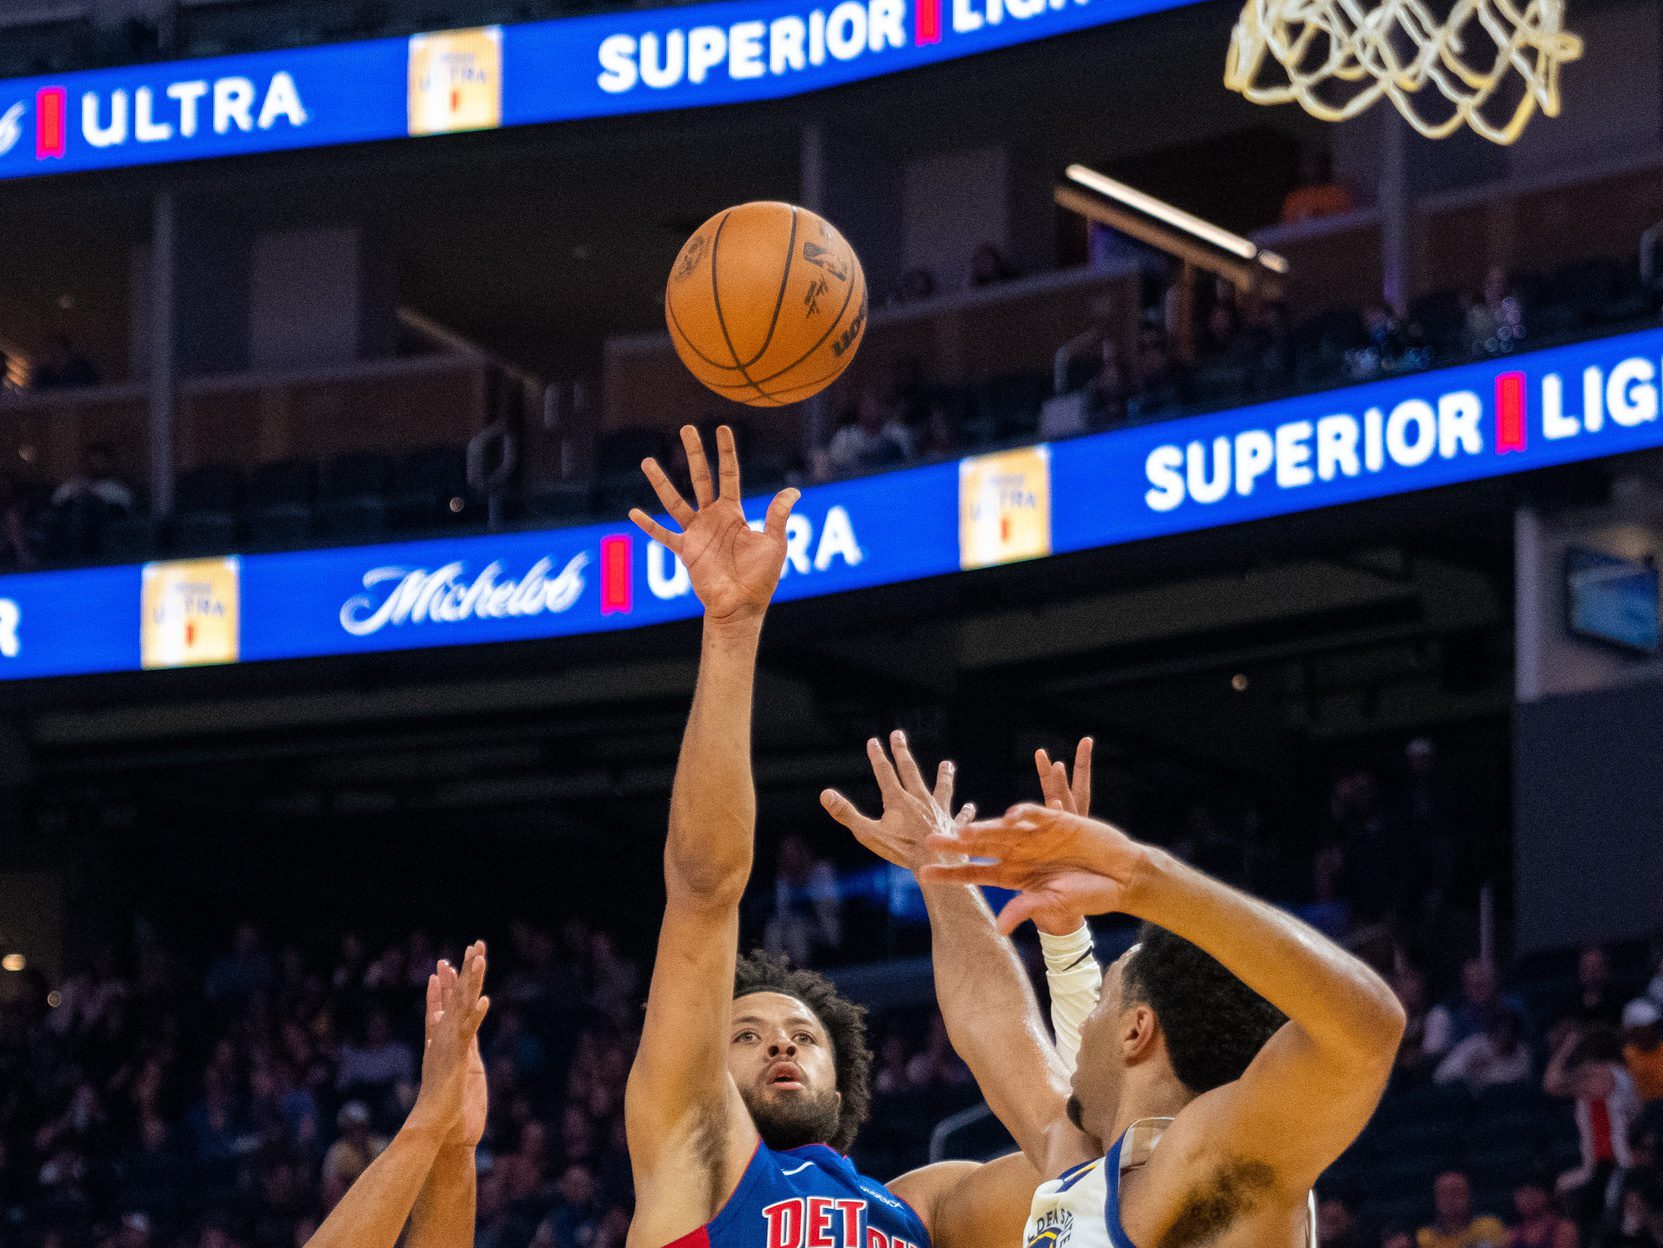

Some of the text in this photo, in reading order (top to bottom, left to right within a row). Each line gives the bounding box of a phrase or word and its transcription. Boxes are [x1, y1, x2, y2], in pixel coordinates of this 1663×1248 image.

[597, 0, 906, 93] SUPERIOR
[81, 71, 308, 147] ULTRA
[1144, 356, 1663, 512] SUPERIOR LIG
[339, 506, 864, 636] Michelob URA
